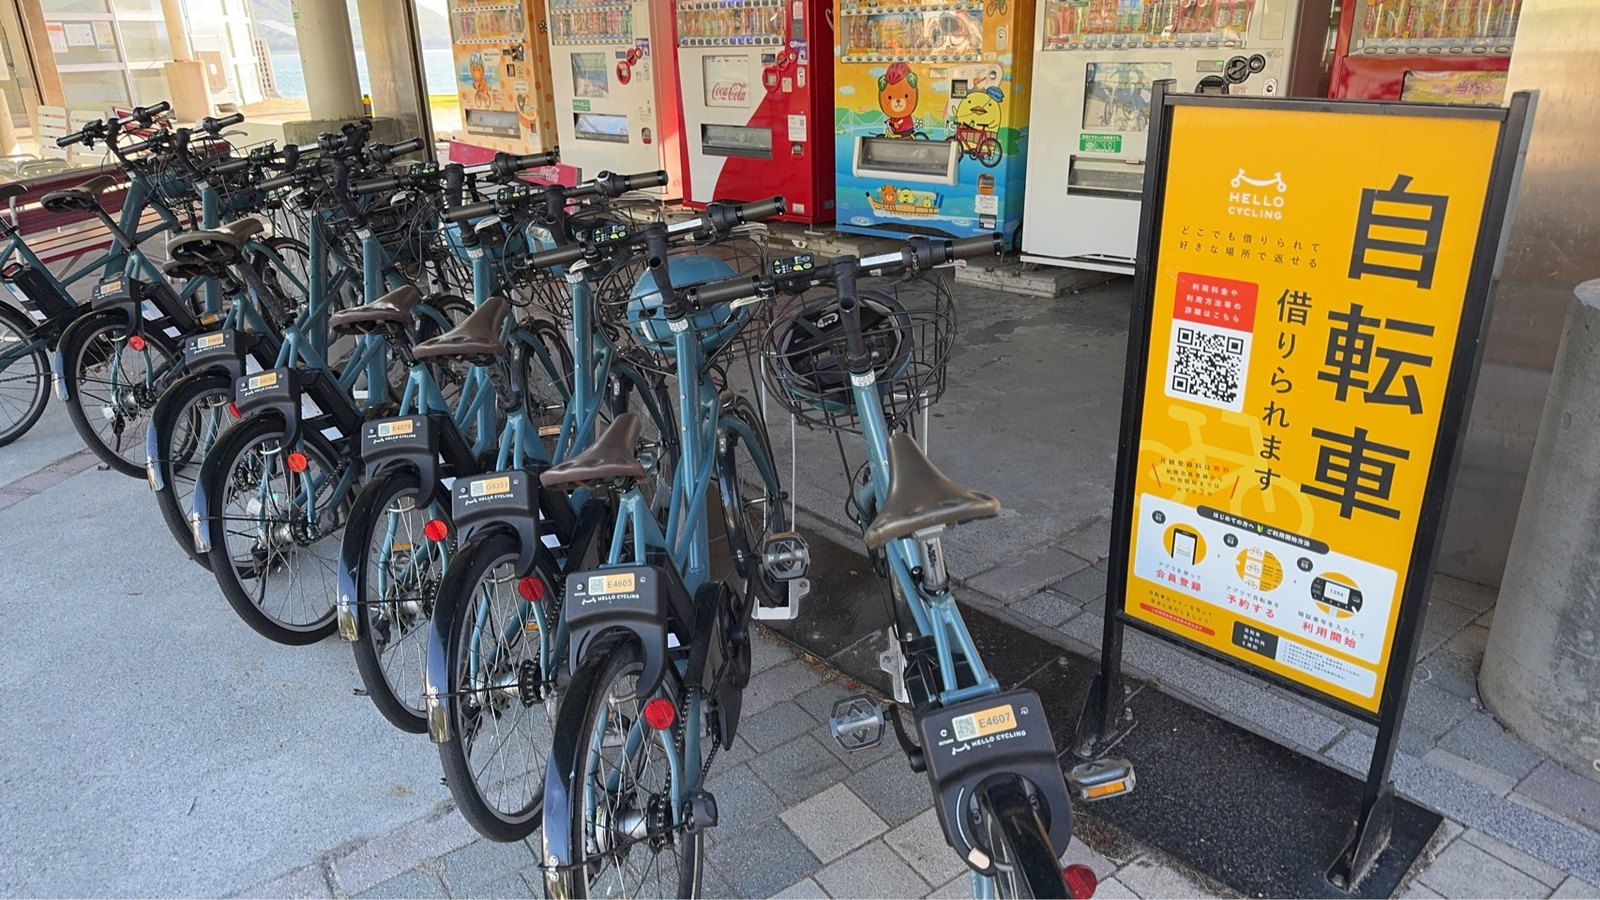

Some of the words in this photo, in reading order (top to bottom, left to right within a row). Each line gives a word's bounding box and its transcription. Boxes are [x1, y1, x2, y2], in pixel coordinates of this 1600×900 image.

[1229, 192, 1285, 208] HELLO
[1228, 206, 1282, 220] CYCLING
[1181, 225, 1321, 252] どこでも借りられて
[1179, 240, 1318, 268] 好きな場所で返せる
[1192, 283, 1238, 296] 利用料金や
[1186, 294, 1241, 310] 利用方法等の
[1184, 306, 1239, 323] 詳細はこちら
[1300, 174, 1449, 520] 自転車
[1255, 288, 1312, 491] 借りられます
[607, 579, 633, 589] E4605
[1155, 569, 1201, 592] 会員登録
[1226, 593, 1275, 618] 予約する
[1302, 621, 1356, 648] 利用開始
[978, 712, 1011, 729] E4607
[971, 736, 995, 747] HELLO
[995, 729, 1027, 741] CYCLING
